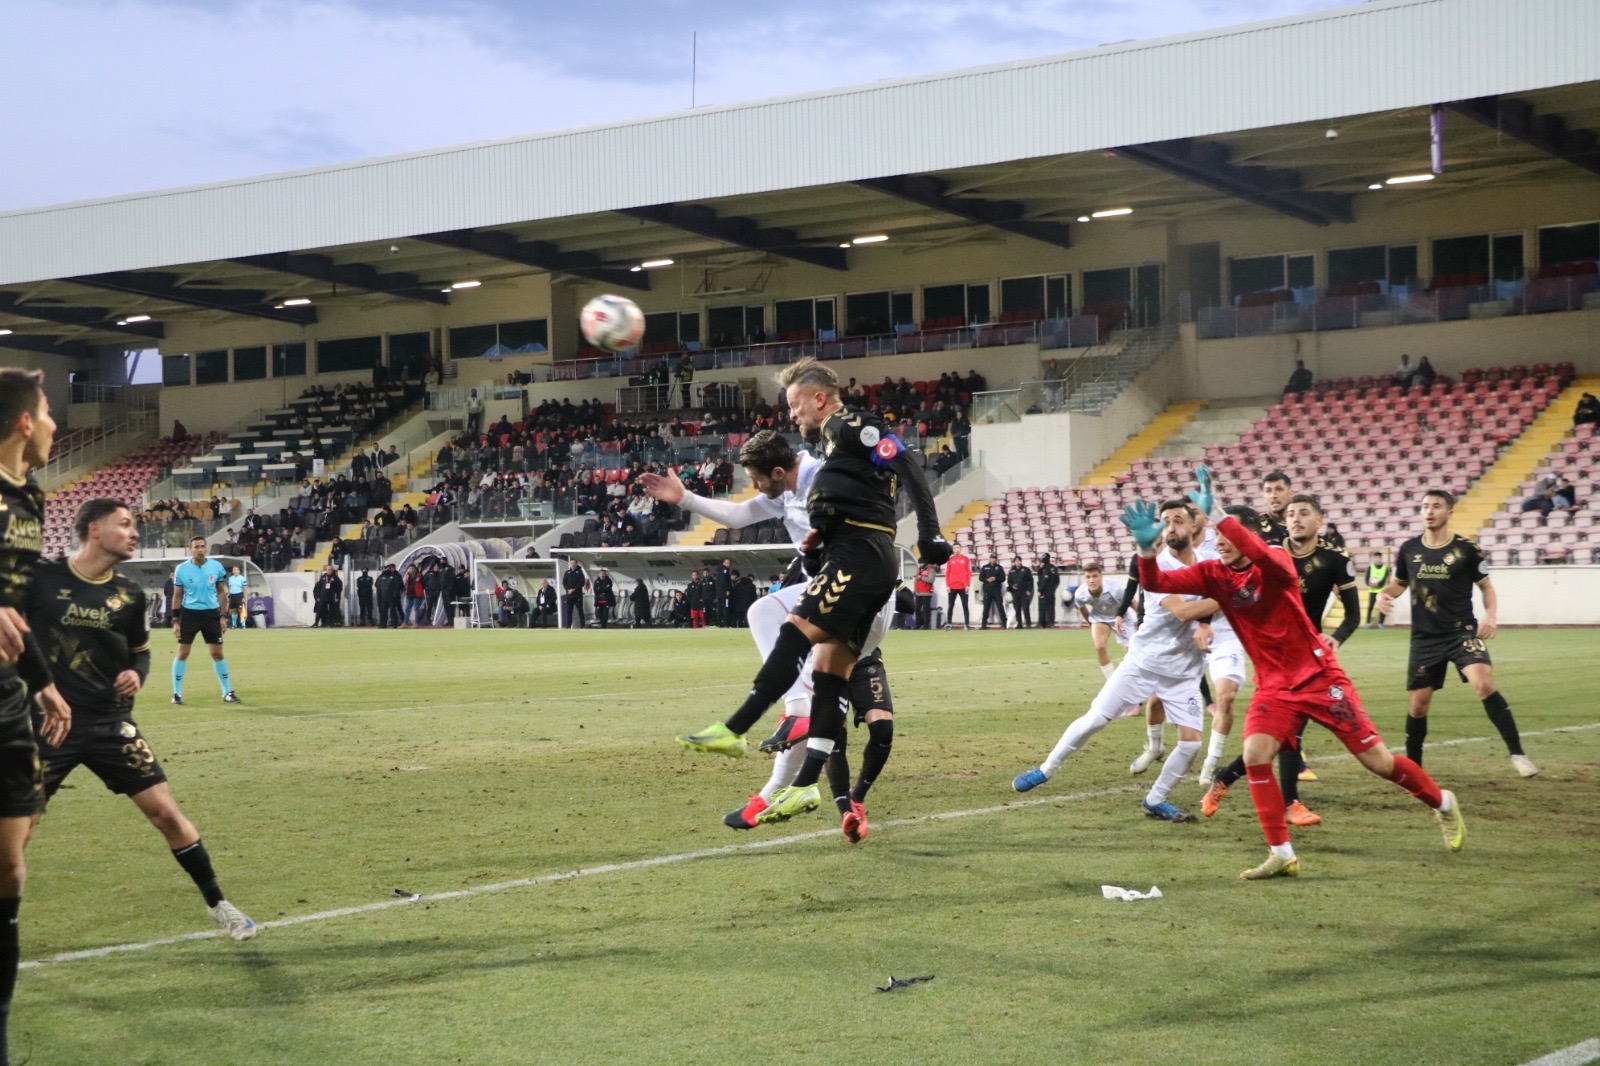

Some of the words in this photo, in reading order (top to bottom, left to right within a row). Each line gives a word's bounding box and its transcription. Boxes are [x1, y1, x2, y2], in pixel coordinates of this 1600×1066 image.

[1420, 563, 1449, 573] Avek
[65, 603, 111, 621] Avek
[122, 738, 155, 769] 33
